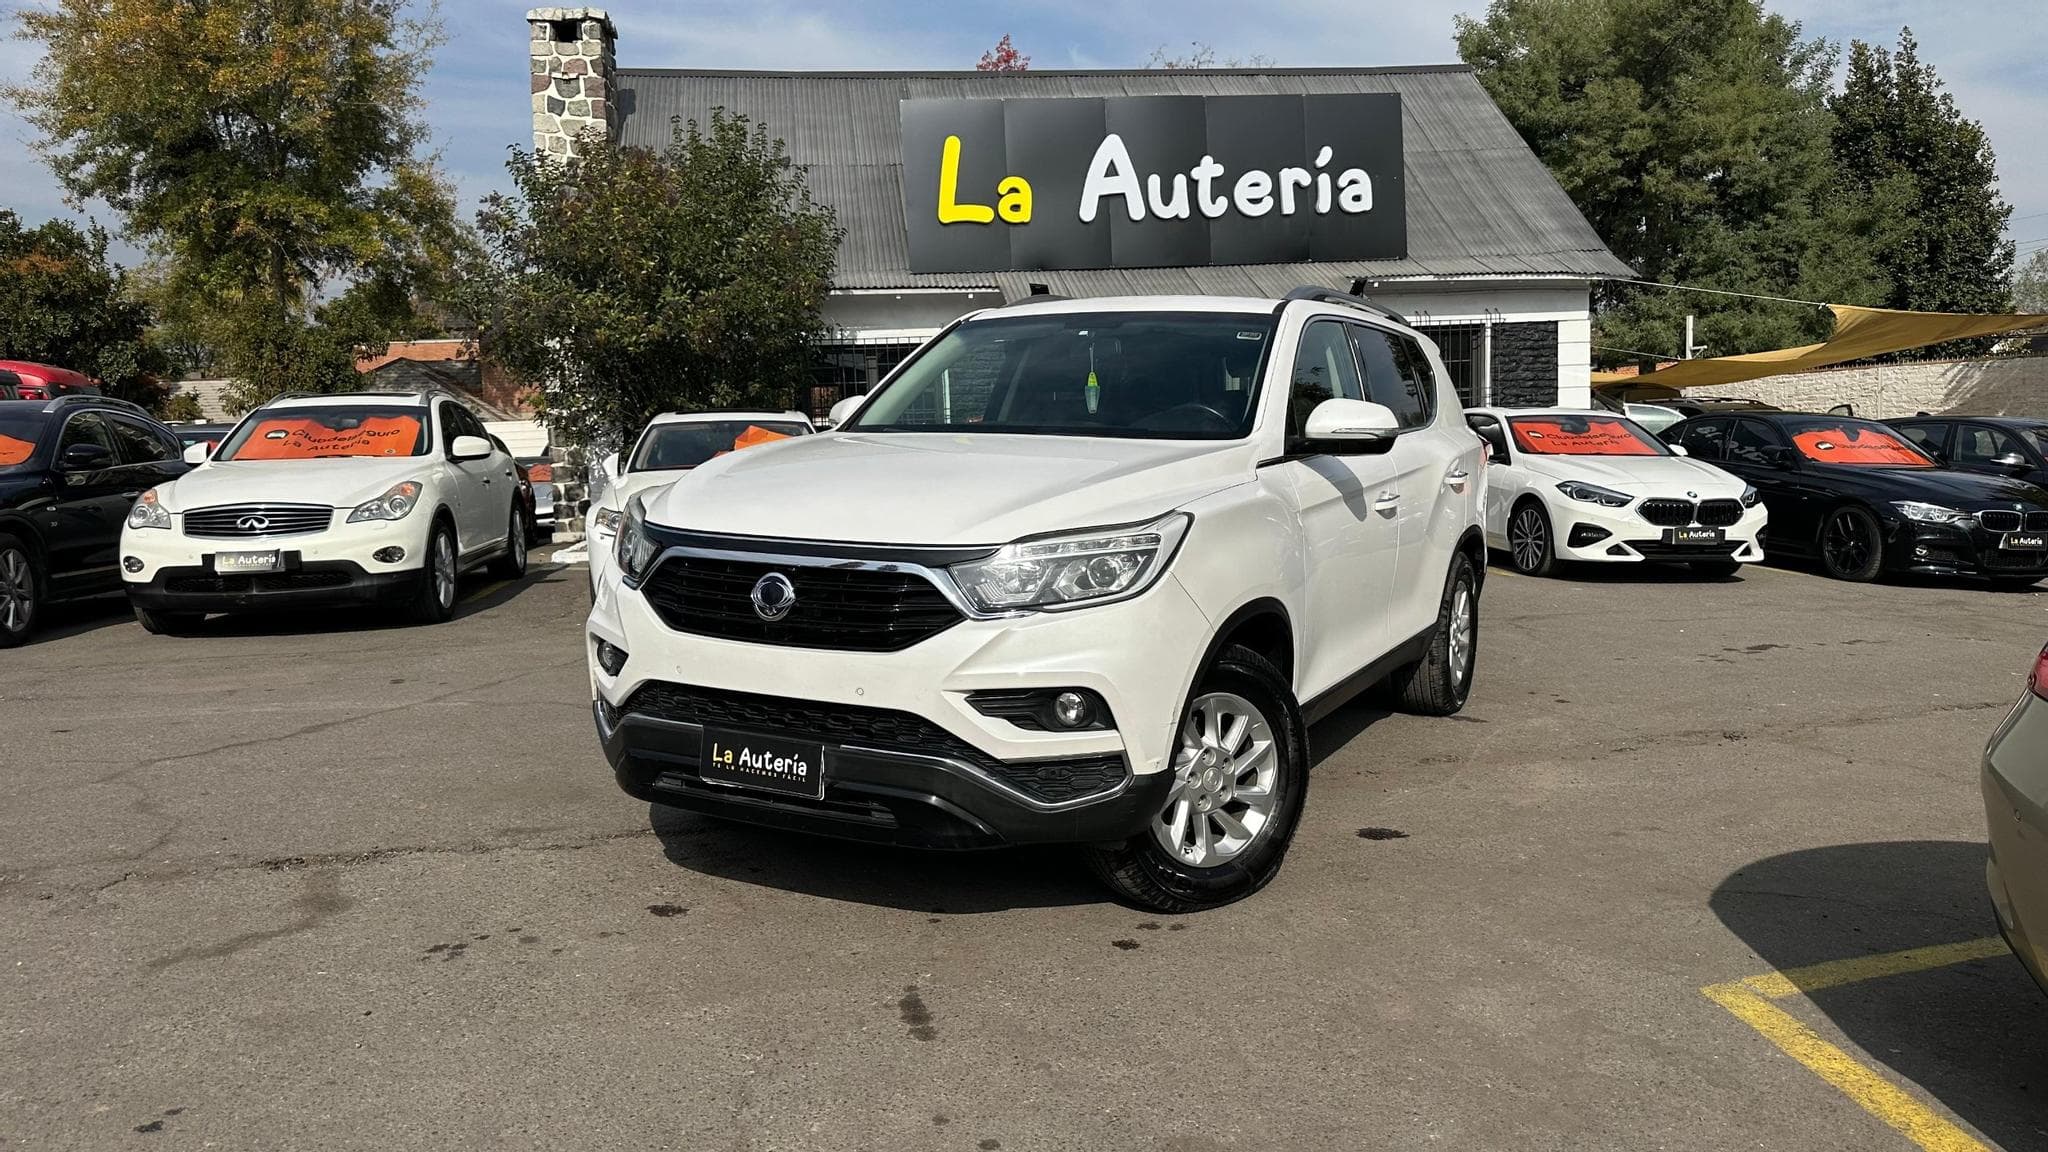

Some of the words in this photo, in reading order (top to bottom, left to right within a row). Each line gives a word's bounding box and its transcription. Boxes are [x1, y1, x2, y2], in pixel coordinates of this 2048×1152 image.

[937, 135, 1033, 224] La
[1078, 133, 1374, 223] Autería
[222, 556, 235, 565] La
[712, 742, 733, 764] La
[738, 747, 808, 776] Autería
